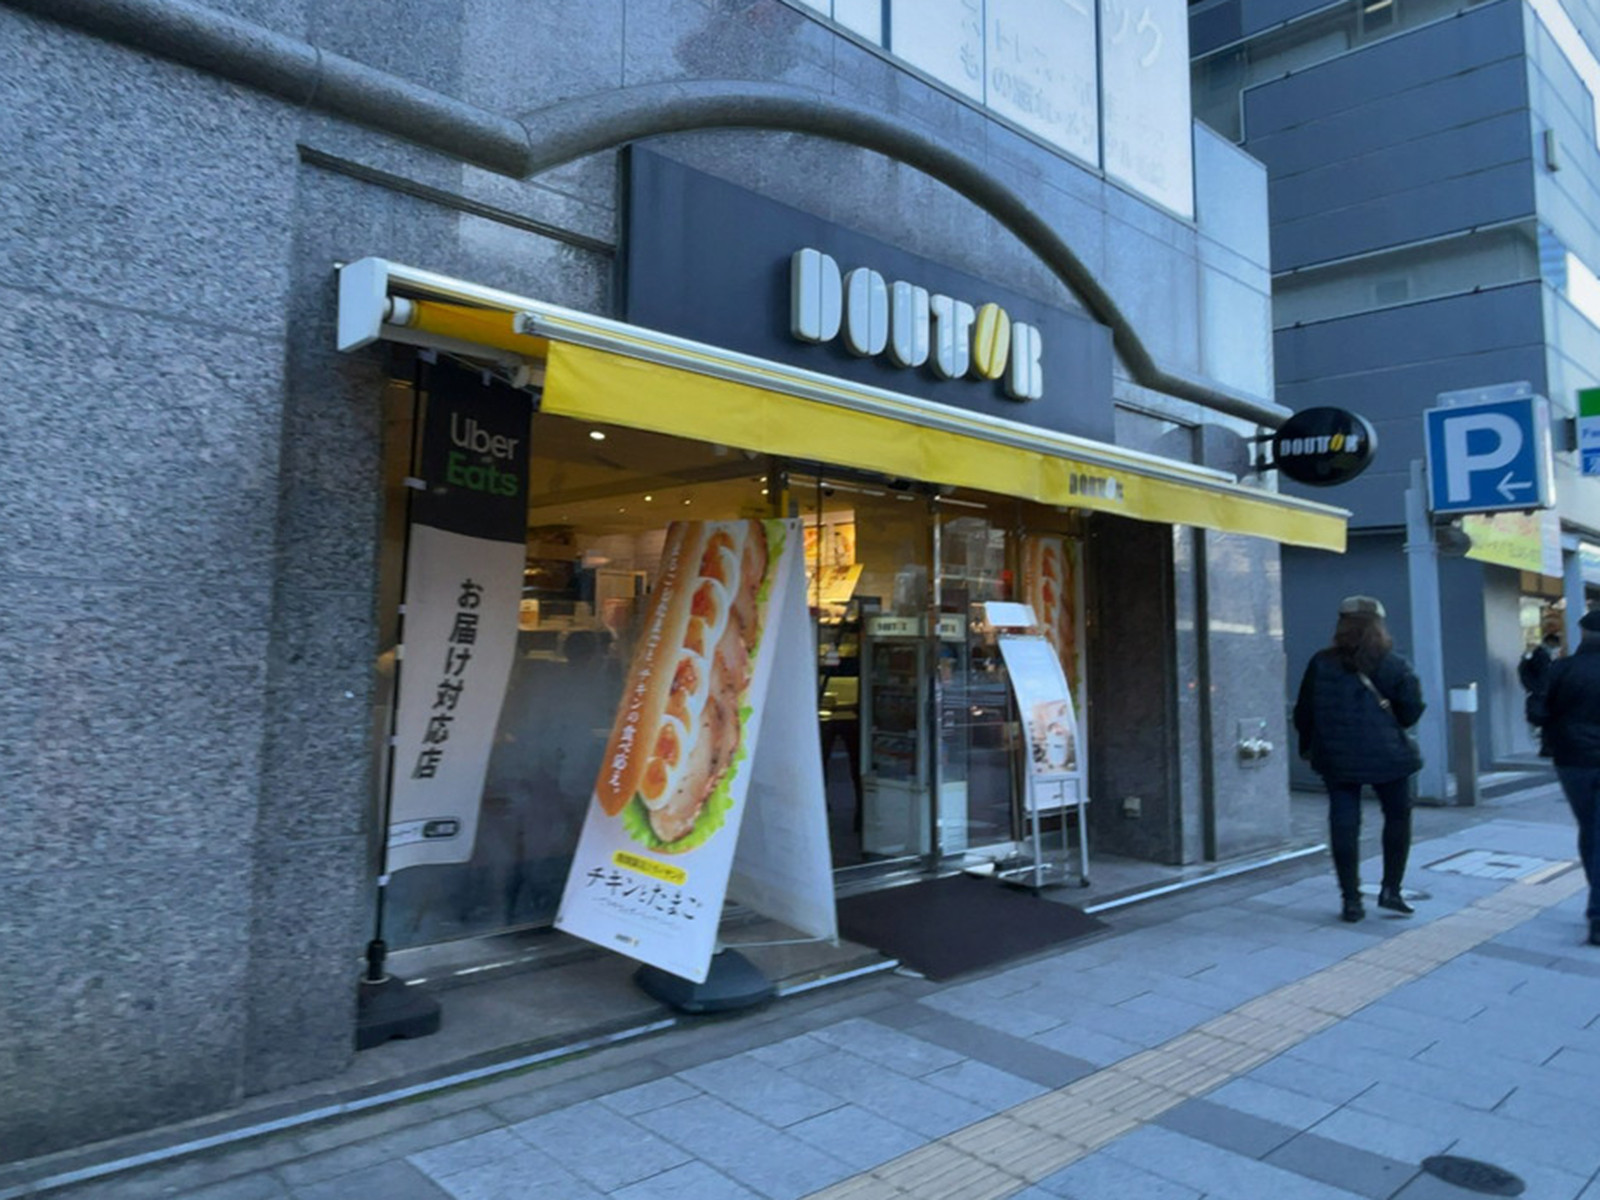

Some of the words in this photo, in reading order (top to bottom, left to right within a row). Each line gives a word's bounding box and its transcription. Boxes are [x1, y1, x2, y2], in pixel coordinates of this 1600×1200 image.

[791, 248, 1043, 400] DOUTOR
[451, 412, 519, 460] Uber
[1280, 434, 1358, 456] DOUTOR
[1444, 412, 1523, 503] P
[447, 451, 518, 496] Eats
[411, 578, 484, 780] お届け対応店
[587, 867, 702, 920] チキンとたまご
